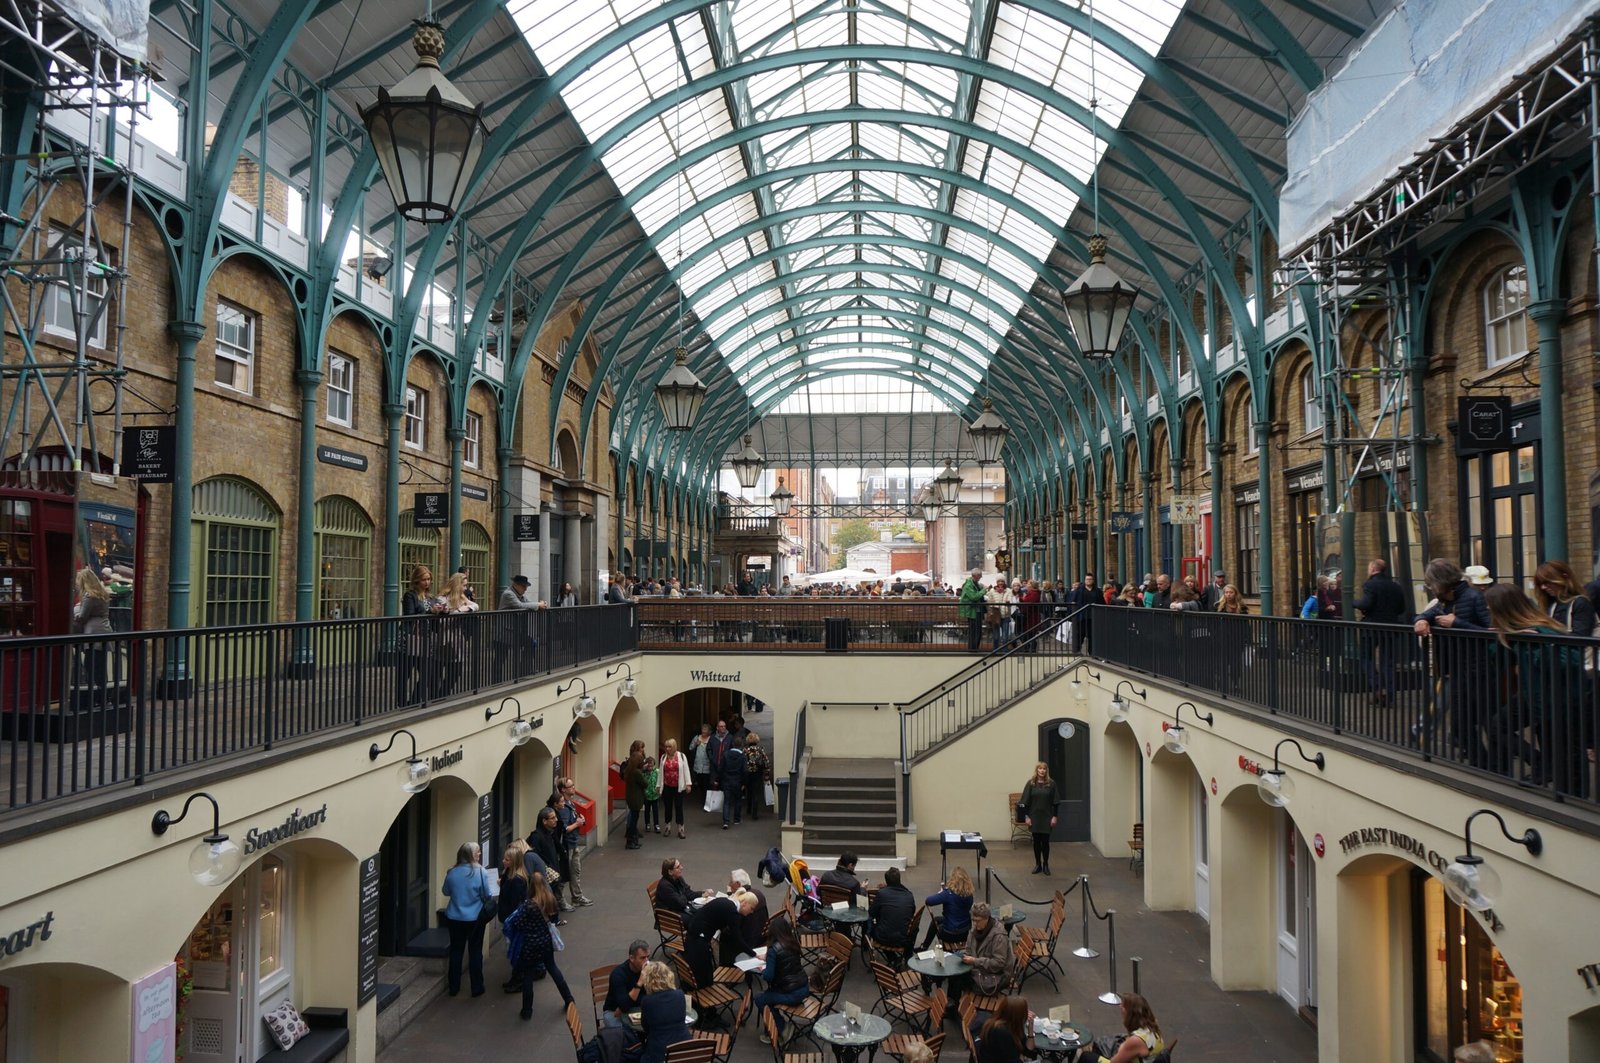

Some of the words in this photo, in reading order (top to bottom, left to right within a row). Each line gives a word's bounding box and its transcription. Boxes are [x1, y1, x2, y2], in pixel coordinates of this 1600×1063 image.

[1243, 488, 1261, 503] Vench
[690, 670, 741, 682] Whittard
[431, 744, 463, 772] Italiani
[243, 803, 327, 855] Sweetheart
[1339, 831, 1361, 853] THE
[1360, 828, 1389, 844] EAST
[1388, 830, 1427, 861] INDIA
